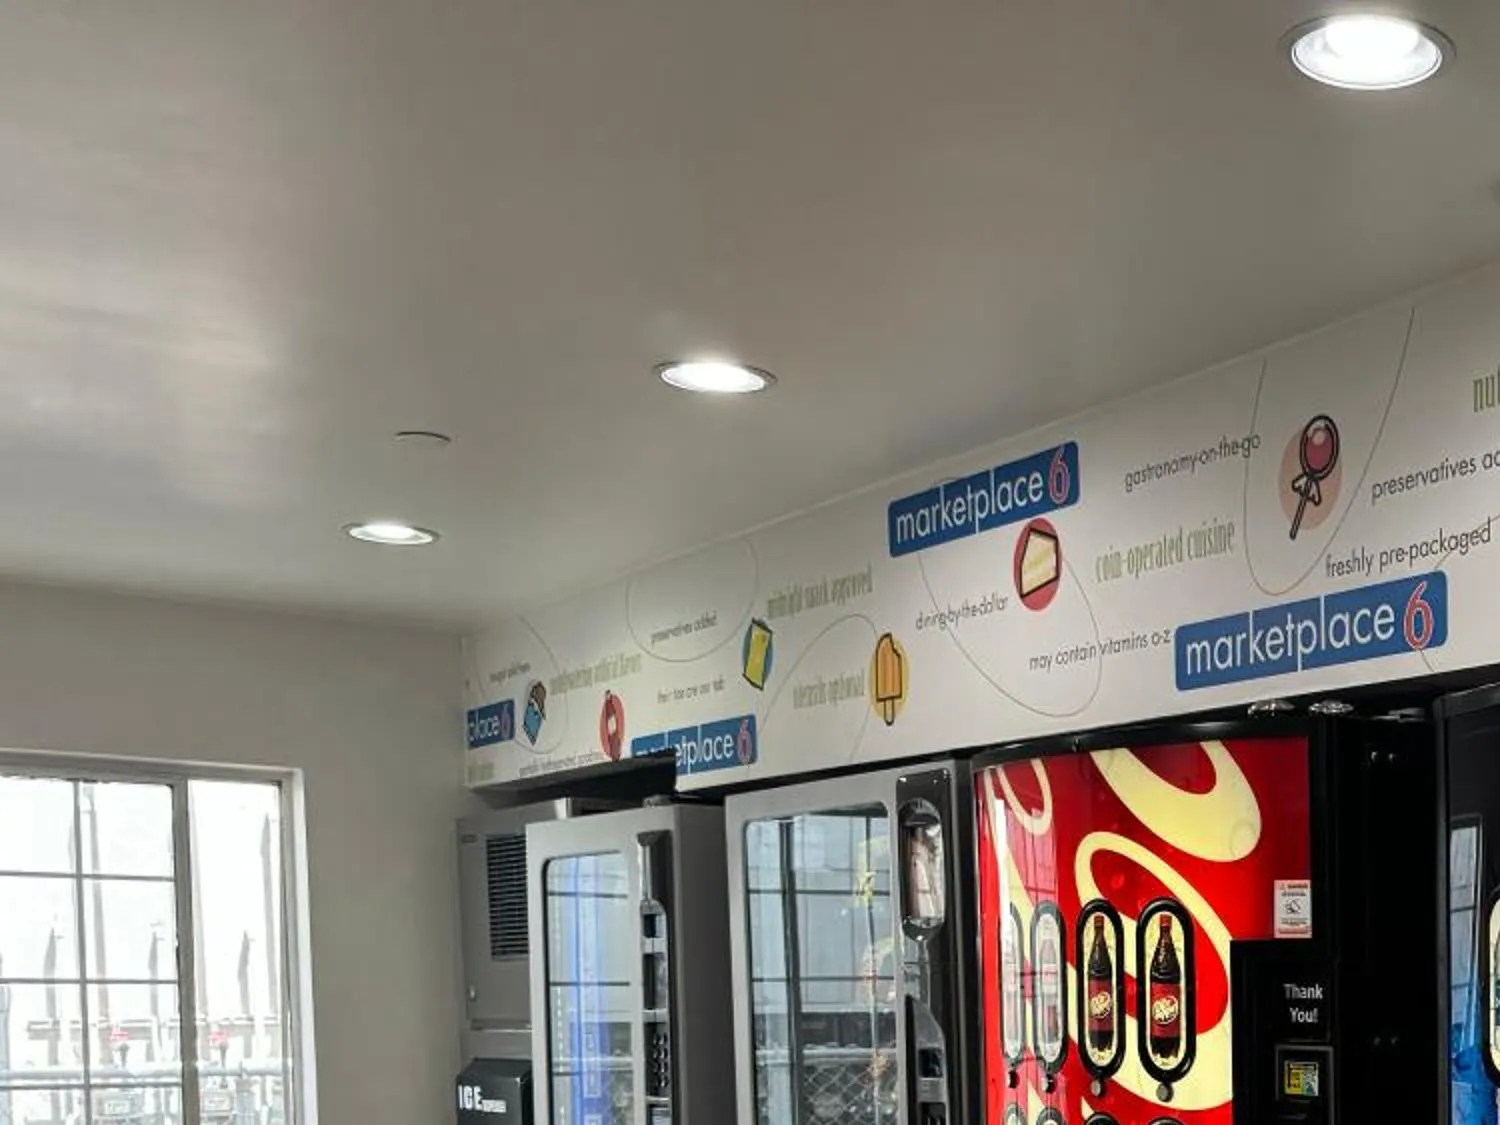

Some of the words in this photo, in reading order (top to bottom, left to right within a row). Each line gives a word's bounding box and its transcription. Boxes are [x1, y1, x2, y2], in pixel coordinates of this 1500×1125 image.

[895, 468, 1044, 543] marketplace
[1048, 448, 1071, 506] 6
[1371, 454, 1478, 502] preservatives
[1095, 539, 1184, 584] coin-operated
[1186, 518, 1236, 560] cuisine
[1325, 550, 1374, 579] freshly
[1379, 516, 1492, 573] pre-packaged
[1029, 654, 1053, 673] may
[1055, 642, 1097, 667] contain
[1098, 631, 1149, 657] vitamins
[1184, 596, 1397, 678] marketplace
[1403, 580, 1434, 651] 6
[1283, 982, 1324, 1001] Thank
[1289, 1006, 1319, 1024] You!
[457, 1084, 483, 1111] ICE
